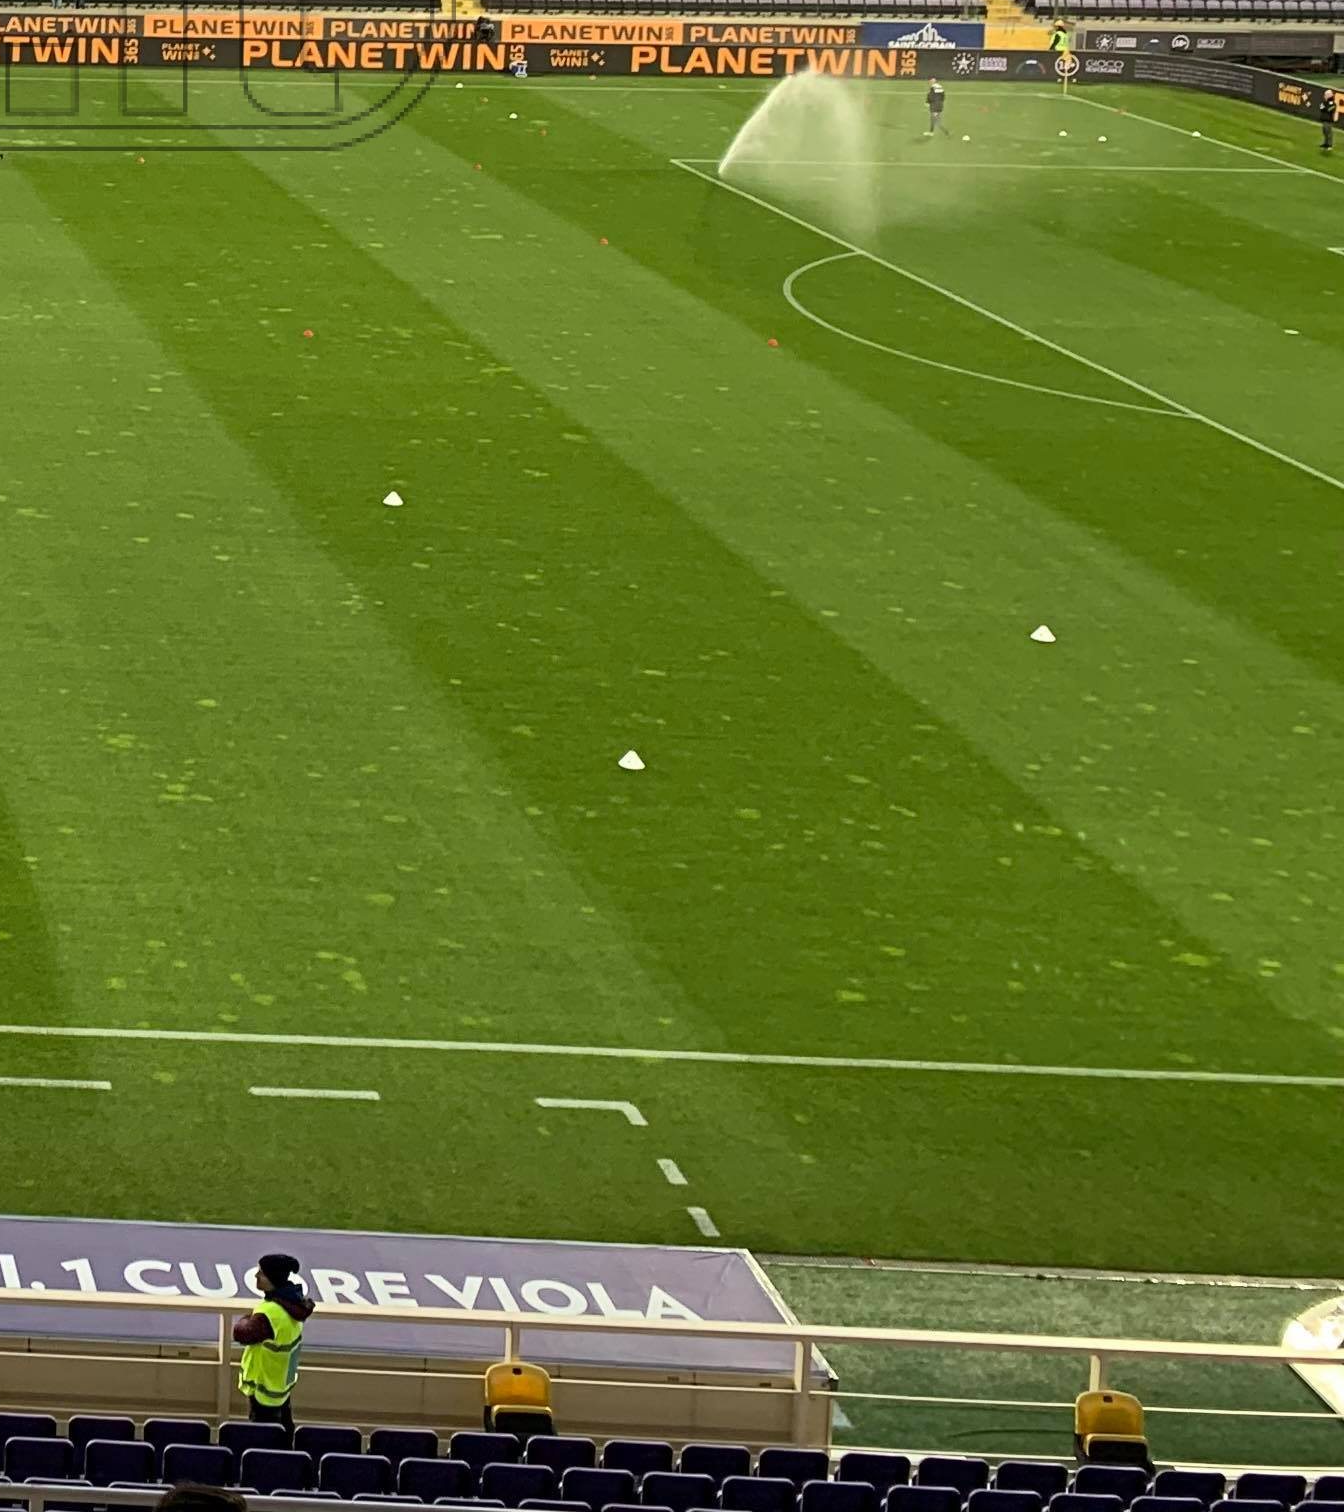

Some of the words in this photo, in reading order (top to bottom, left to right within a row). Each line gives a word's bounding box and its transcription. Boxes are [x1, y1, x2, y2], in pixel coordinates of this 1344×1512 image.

[154, 19, 302, 35] PLANETWIN
[511, 25, 663, 41] PLANETWIN
[690, 27, 844, 44] PLANETWIN
[243, 40, 505, 69] PLANETWIN
[550, 49, 589, 58] PLANET
[631, 46, 896, 77] PLANETWIN
[60, 1258, 99, 1292] 1
[424, 1273, 705, 1322] VIOLA
